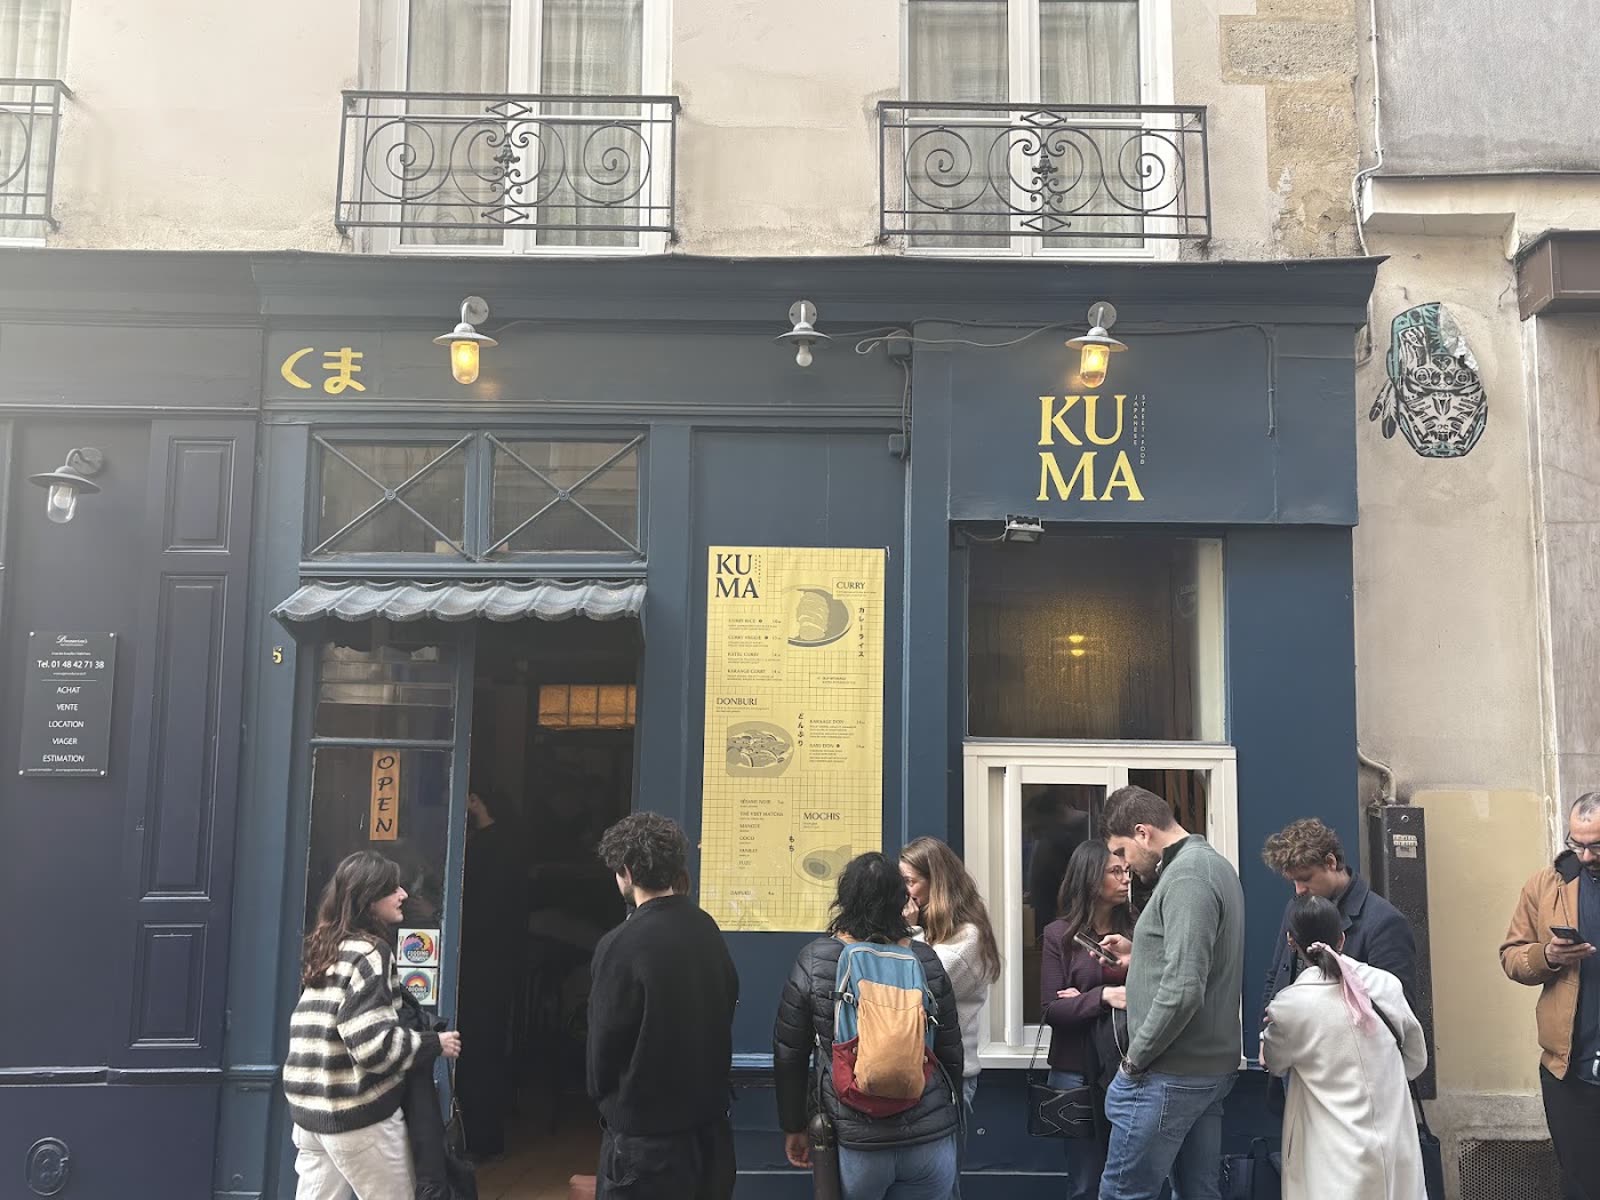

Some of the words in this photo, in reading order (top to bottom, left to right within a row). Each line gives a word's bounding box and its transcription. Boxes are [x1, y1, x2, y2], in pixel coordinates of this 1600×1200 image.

[281, 346, 366, 394] くま
[1038, 394, 1127, 446] KU
[1036, 450, 1145, 501] MA
[716, 553, 752, 575] KU
[715, 577, 759, 599] MA
[836, 581, 866, 590] CURRY
[272, 646, 282, 664] 5
[37, 660, 50, 668] Tel.
[51, 660, 60, 668] 01
[62, 660, 72, 668] 48
[73, 660, 83, 668] 42
[84, 660, 93, 668] 71
[94, 660, 105, 669] 38
[56, 686, 81, 694] ACHAT
[716, 697, 758, 706] DONBURI
[56, 703, 79, 711] VENTE
[48, 720, 84, 728] LOCATION
[797, 712, 805, 747] どんぶり
[52, 737, 78, 745] VIAGER
[42, 754, 85, 762] ESTIMATION
[376, 755, 395, 832] OPEN
[803, 812, 841, 821] MOCHIS
